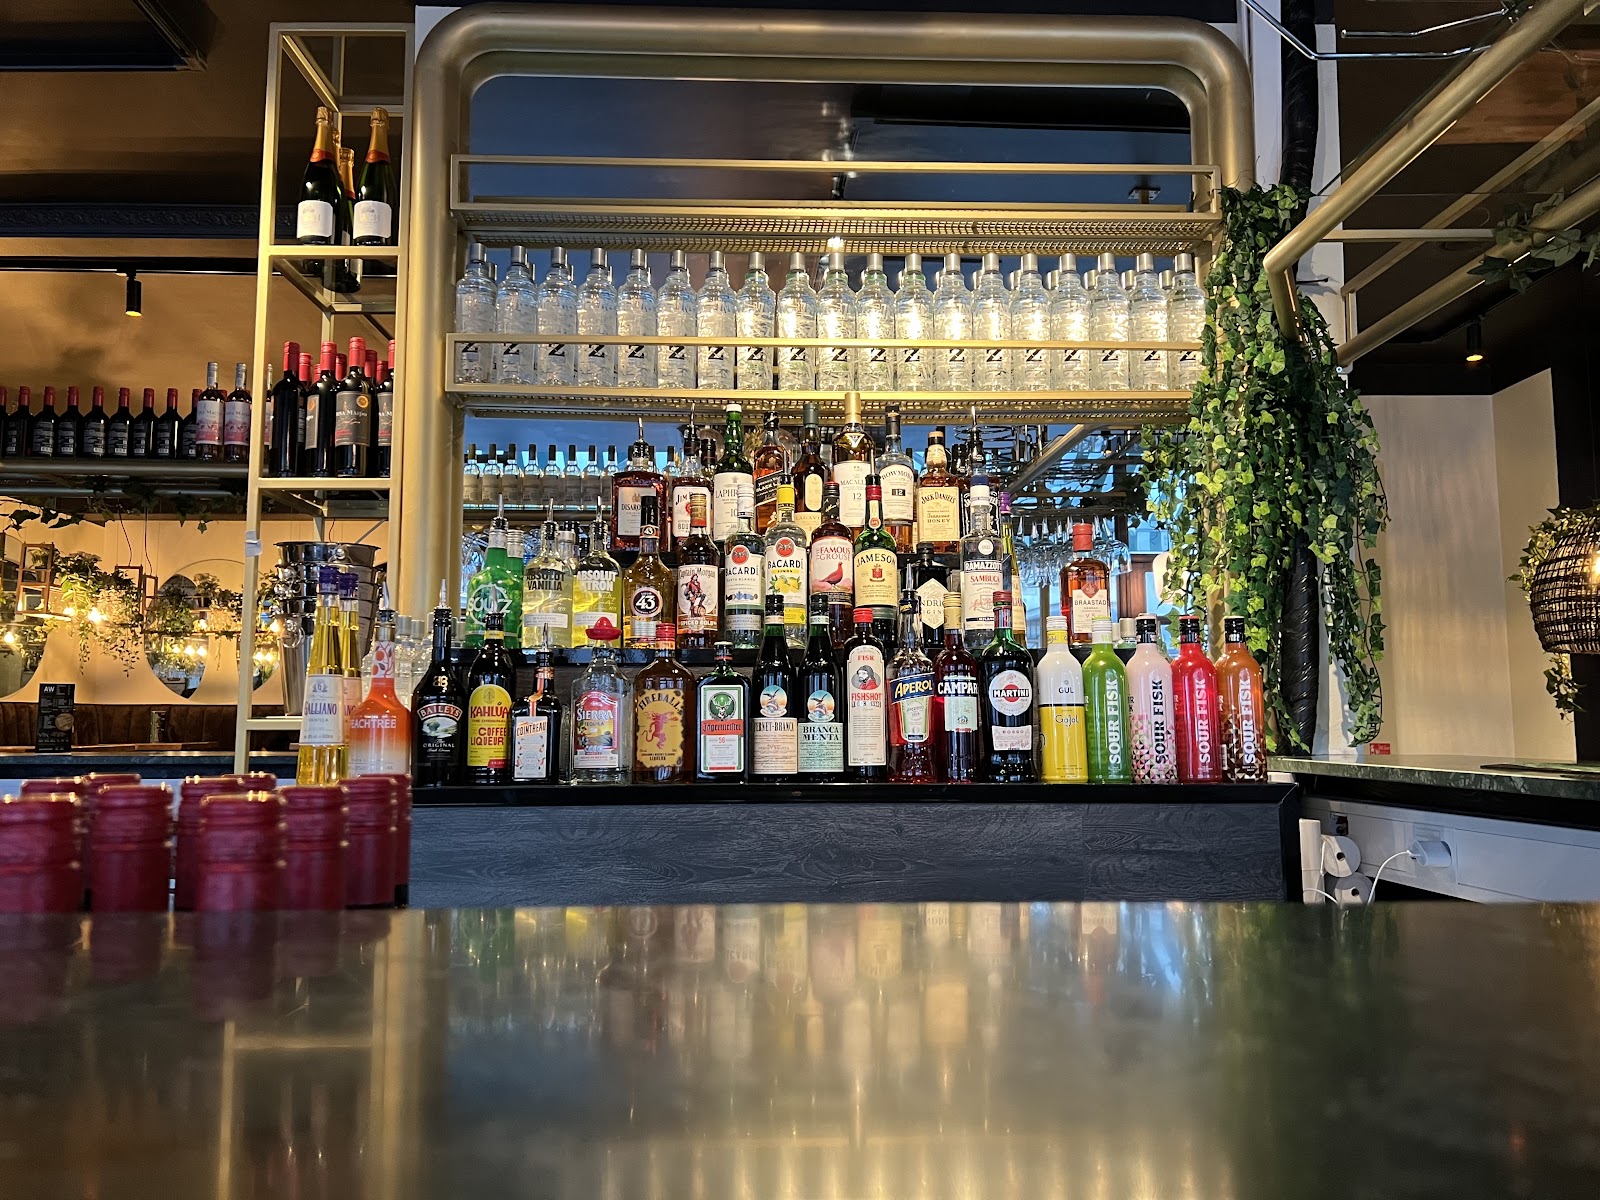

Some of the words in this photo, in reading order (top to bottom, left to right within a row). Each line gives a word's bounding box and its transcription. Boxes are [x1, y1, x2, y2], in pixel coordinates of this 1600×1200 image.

[853, 492, 862, 500] 12
[921, 494, 935, 504] JACK
[856, 553, 896, 567] JAMESON
[526, 570, 566, 581] ABSOLUT
[577, 570, 619, 582] ABSOLUT
[468, 597, 513, 613] SOUZ
[635, 595, 656, 609] 43
[894, 680, 933, 699] APEROL
[993, 689, 1029, 698] MARTINI
[1106, 678, 1119, 715] FISK
[1195, 679, 1207, 715] FISK
[1239, 679, 1252, 715] FISK
[638, 693, 681, 711] FIREBALL
[1152, 680, 1163, 716] FISK
[304, 701, 337, 716] GALLIANO
[420, 706, 460, 717] BAILEYS
[577, 707, 614, 721] SIERRA
[478, 727, 508, 736] COFFEE
[516, 721, 547, 736] COINTREAU
[470, 737, 504, 745] LIQUEUR
[1108, 720, 1121, 764] SOUR
[1154, 720, 1167, 764] SOUR
[1197, 719, 1211, 763] SOUR
[1242, 719, 1256, 764] SOUR
